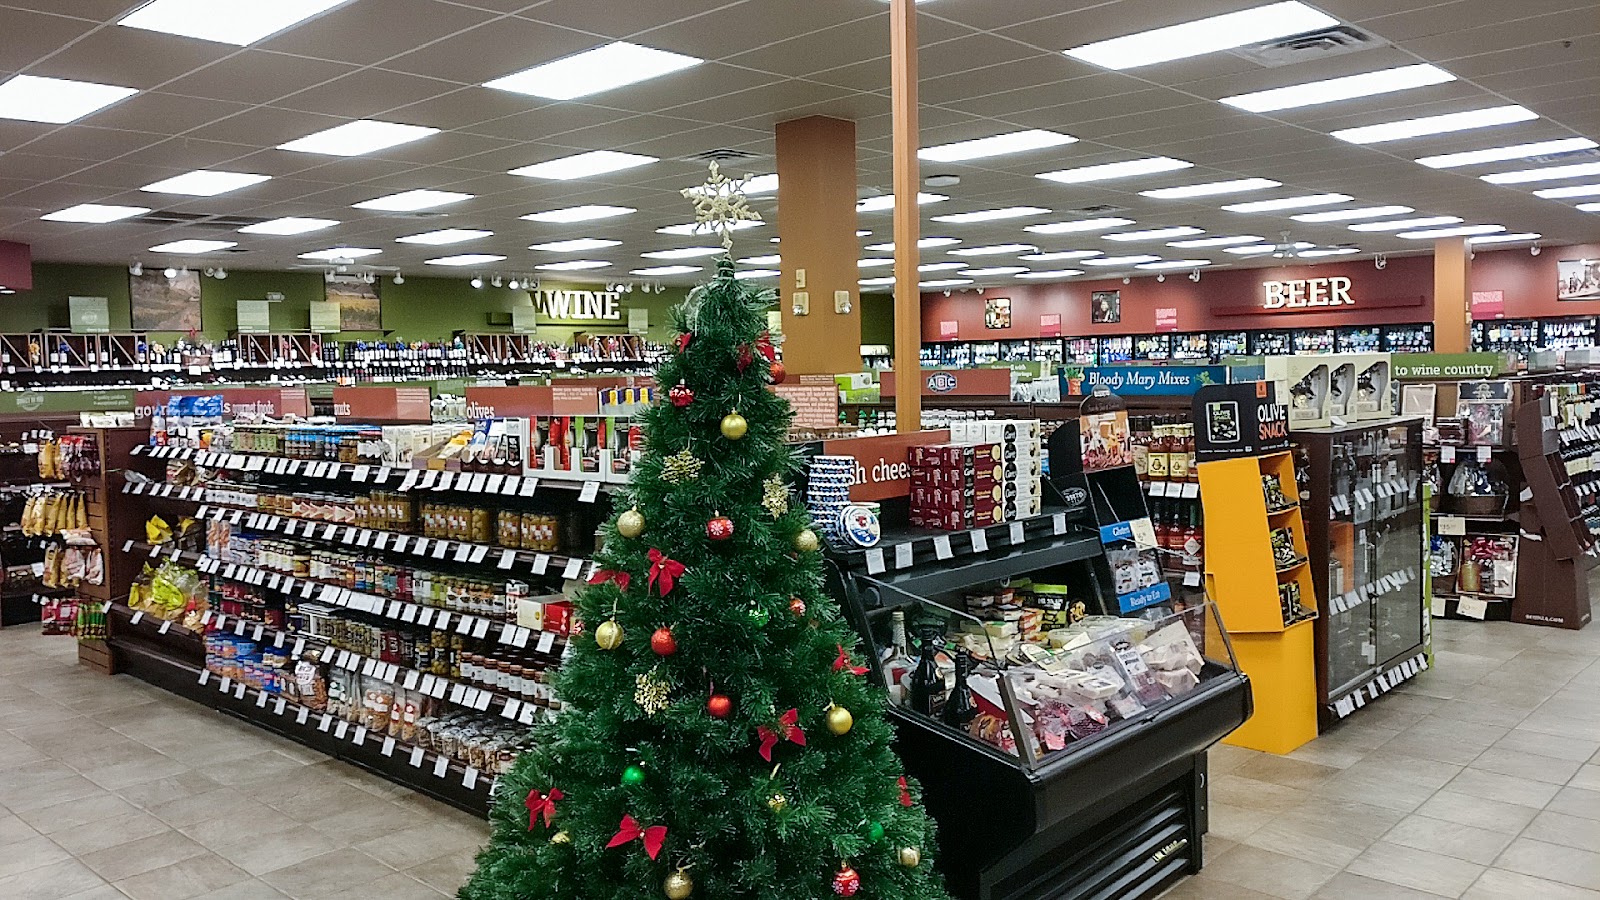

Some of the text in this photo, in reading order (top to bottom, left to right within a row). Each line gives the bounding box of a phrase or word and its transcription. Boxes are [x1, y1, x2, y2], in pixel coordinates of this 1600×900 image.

[1263, 277, 1355, 309] BEER
[544, 290, 620, 319] WINE
[1395, 364, 1494, 377] to wine country
[1088, 371, 1190, 390] Bloody Mary Mixes
[466, 401, 495, 419] olives
[1257, 403, 1286, 422] OLIVE
[1259, 420, 1288, 440] SNACK
[871, 457, 911, 483] chee
